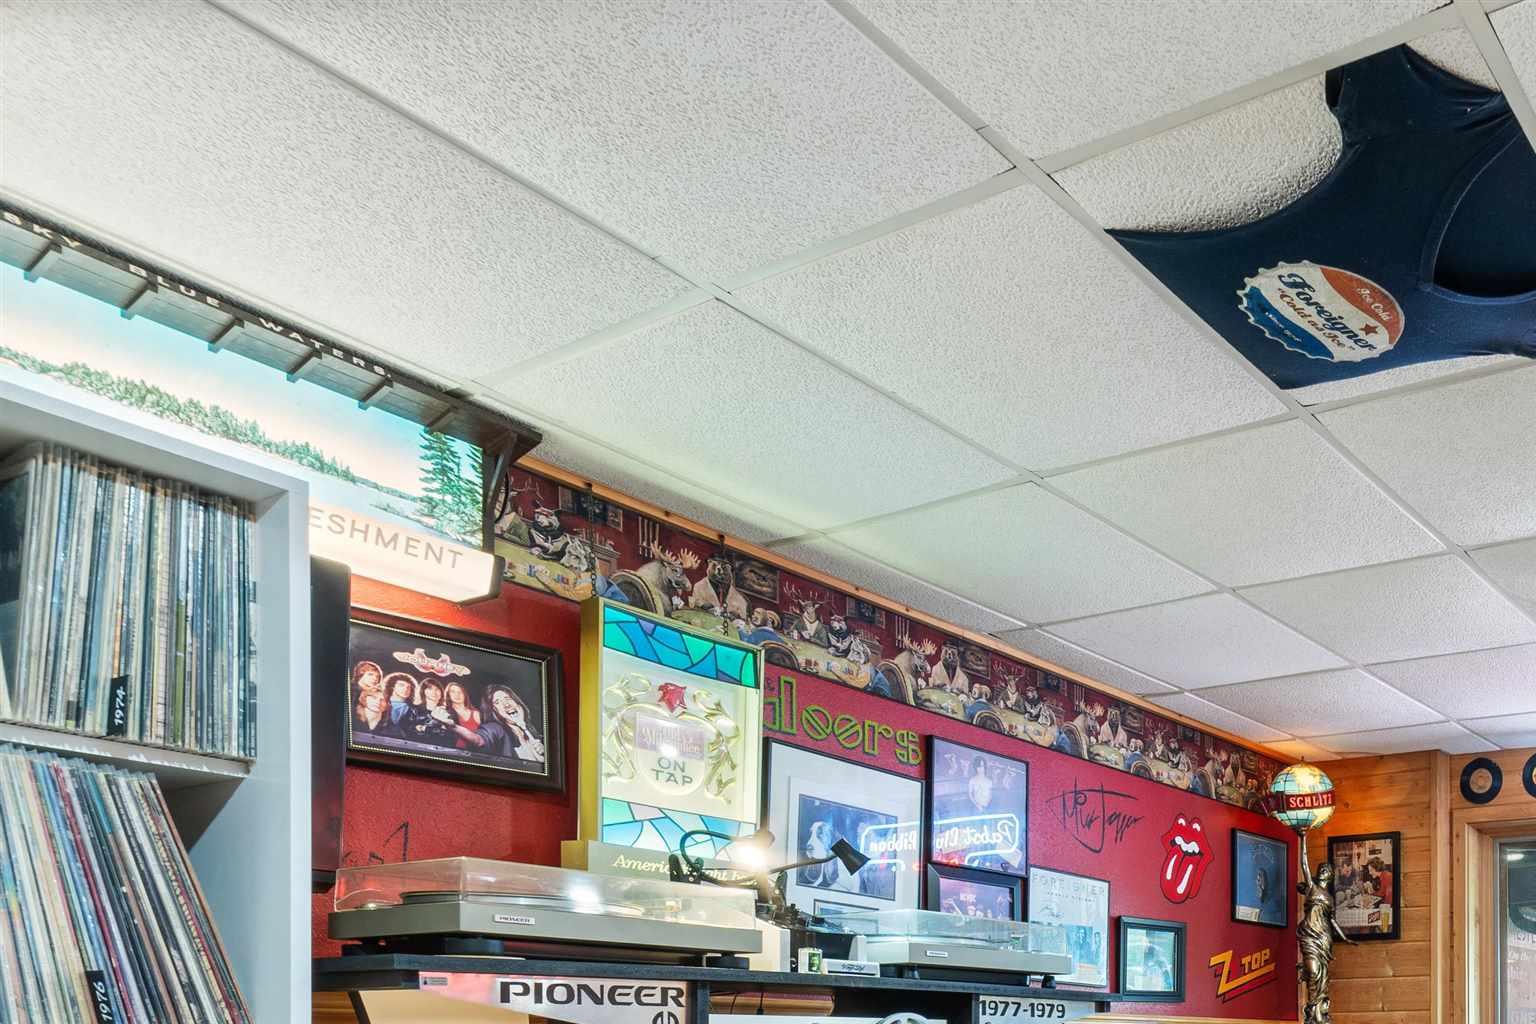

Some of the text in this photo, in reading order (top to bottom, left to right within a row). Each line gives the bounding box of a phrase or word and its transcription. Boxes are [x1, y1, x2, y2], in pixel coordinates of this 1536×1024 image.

[3, 210, 81, 248] SKY
[128, 263, 221, 308] BLUE
[1277, 272, 1378, 352] Foreigner
[1370, 302, 1393, 321] Cold
[112, 685, 127, 727] 1974
[651, 768, 694, 788] TAP
[657, 756, 686, 775] ON
[1289, 793, 1333, 809] SCHLITZ
[1240, 948, 1271, 974] TOP
[100, 980, 112, 1022] 1976
[499, 981, 686, 1009] PIONEER
[978, 999, 1067, 1020] 1977-1979
